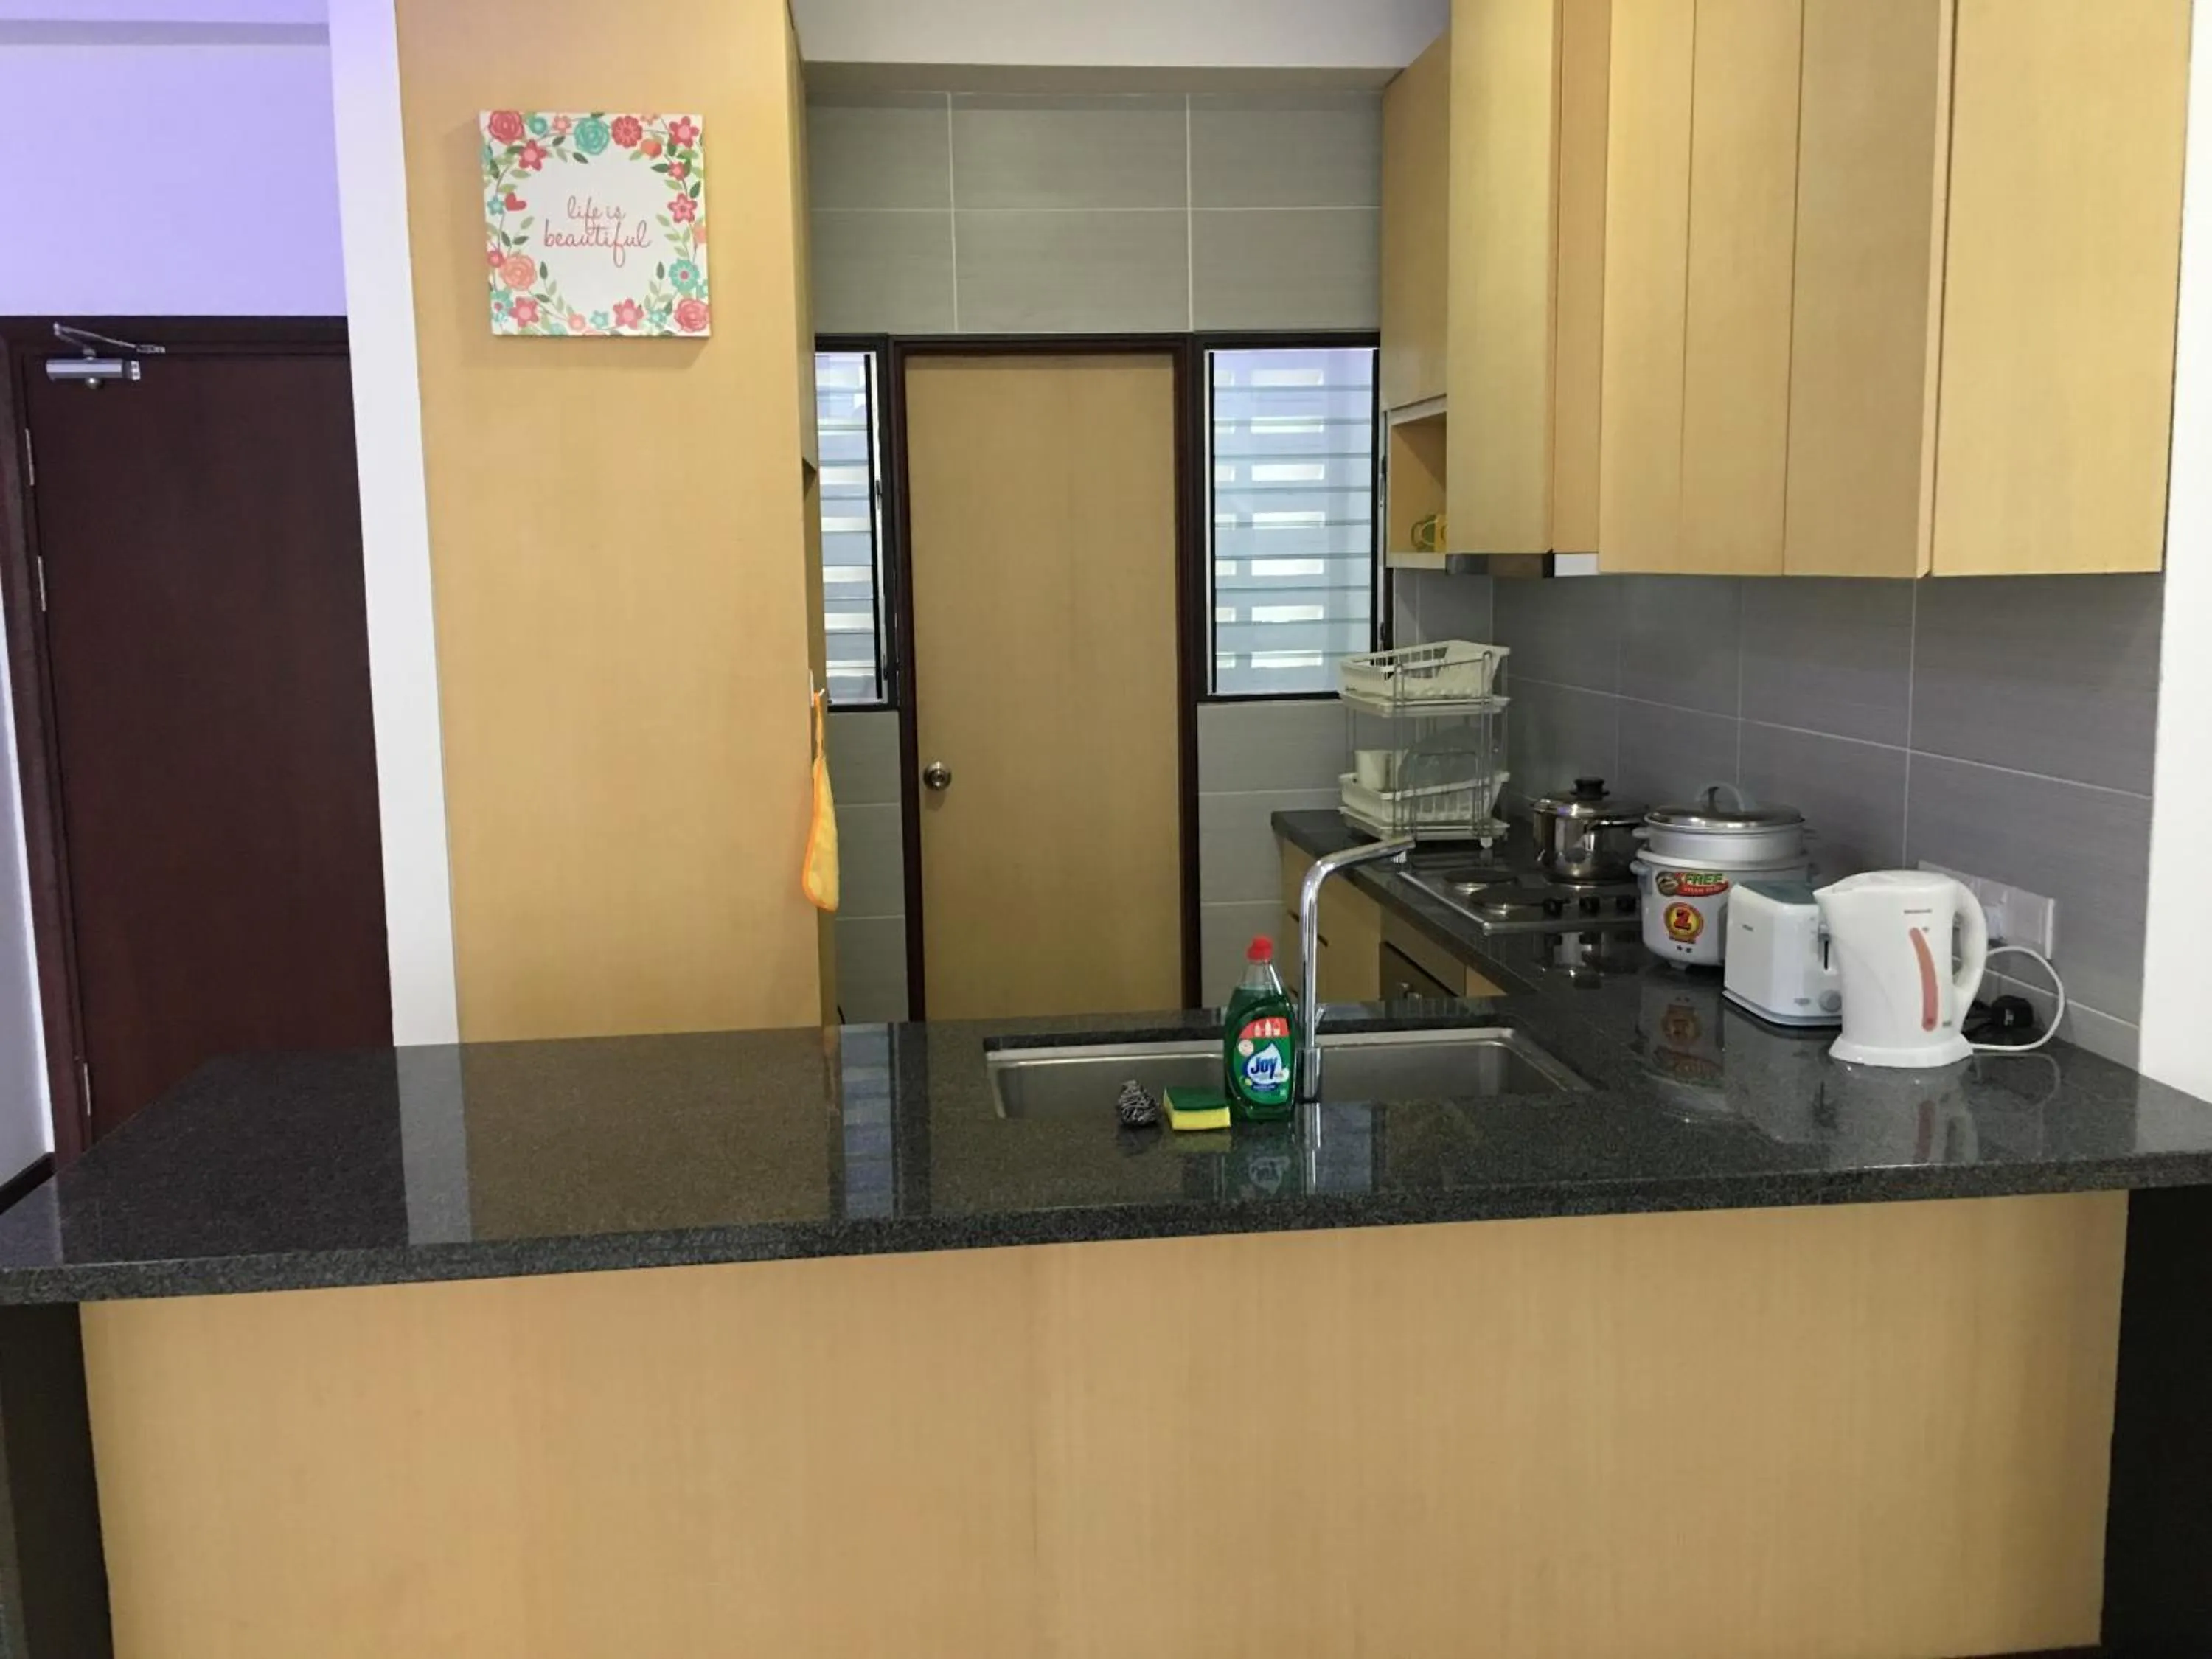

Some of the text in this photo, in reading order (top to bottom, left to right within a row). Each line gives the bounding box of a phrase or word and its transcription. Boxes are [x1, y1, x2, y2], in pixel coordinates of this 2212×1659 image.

[567, 195, 625, 234] life is
[543, 219, 651, 268] beautiful
[1685, 873, 1723, 885] FREE
[1674, 909, 1692, 931] 2
[1251, 1057, 1278, 1079] Joy
